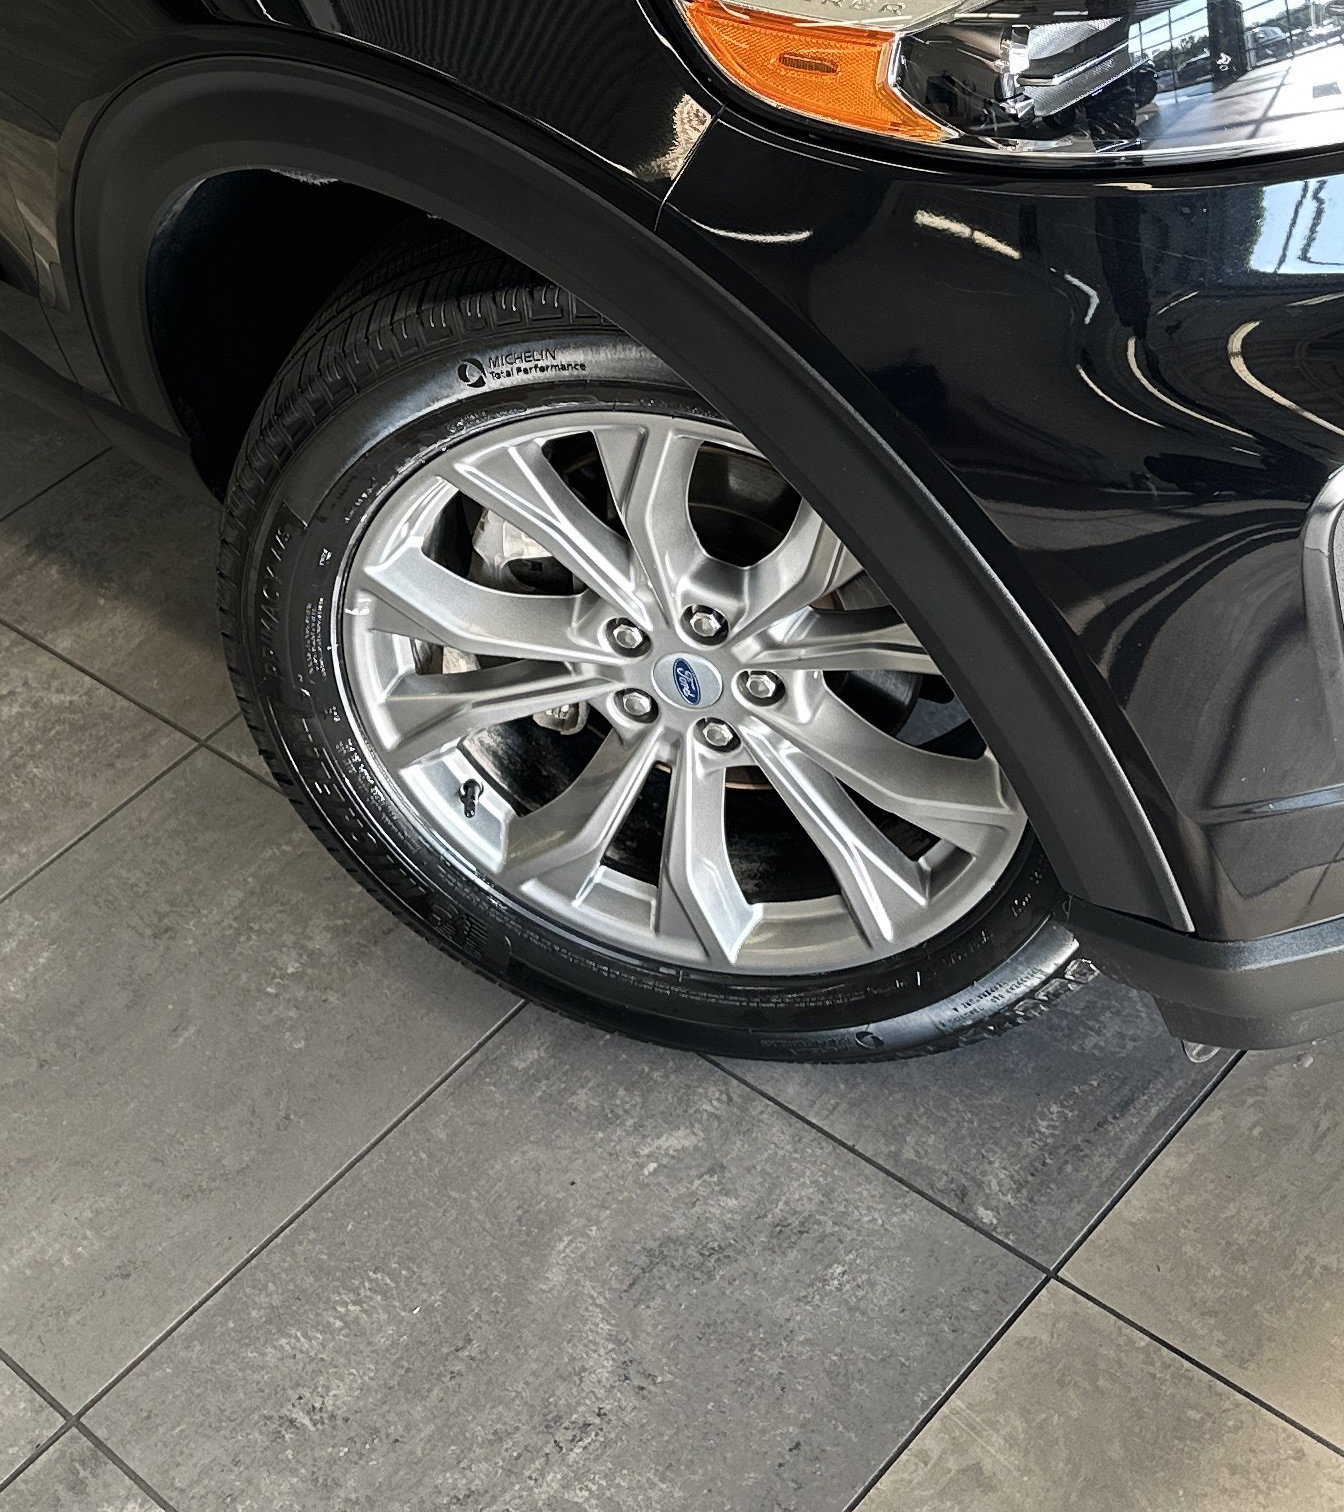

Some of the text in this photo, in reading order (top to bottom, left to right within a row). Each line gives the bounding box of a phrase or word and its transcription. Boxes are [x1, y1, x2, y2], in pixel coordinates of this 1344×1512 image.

[488, 349, 557, 368] MICHELIN
[489, 362, 587, 380] Total Performance
[677, 667, 696, 698] Ford
